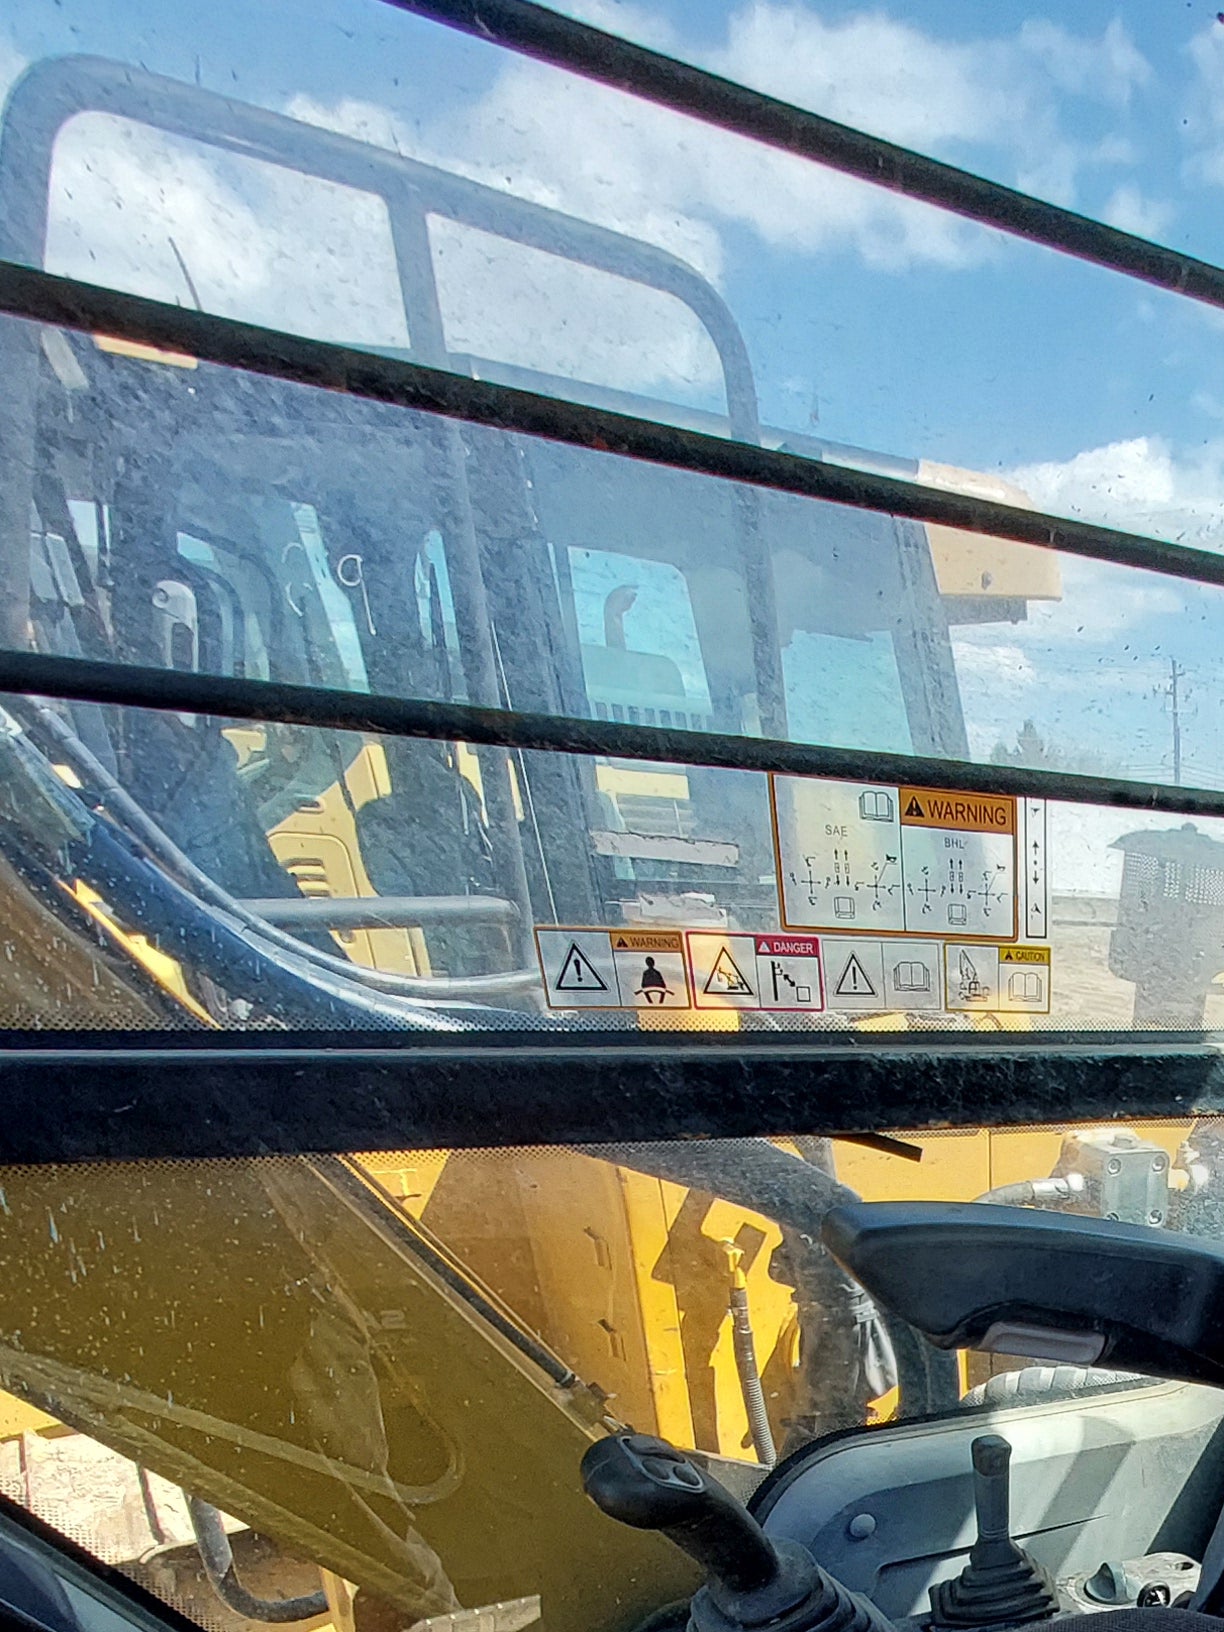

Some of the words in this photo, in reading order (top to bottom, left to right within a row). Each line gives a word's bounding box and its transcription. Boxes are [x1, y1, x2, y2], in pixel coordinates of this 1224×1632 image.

[928, 800, 1007, 826] WARNING
[825, 824, 848, 837] SAE
[944, 837, 966, 849] BHL
[629, 935, 679, 950] WARNING
[773, 941, 814, 955] DANGER
[1015, 950, 1045, 962] CAUTION
